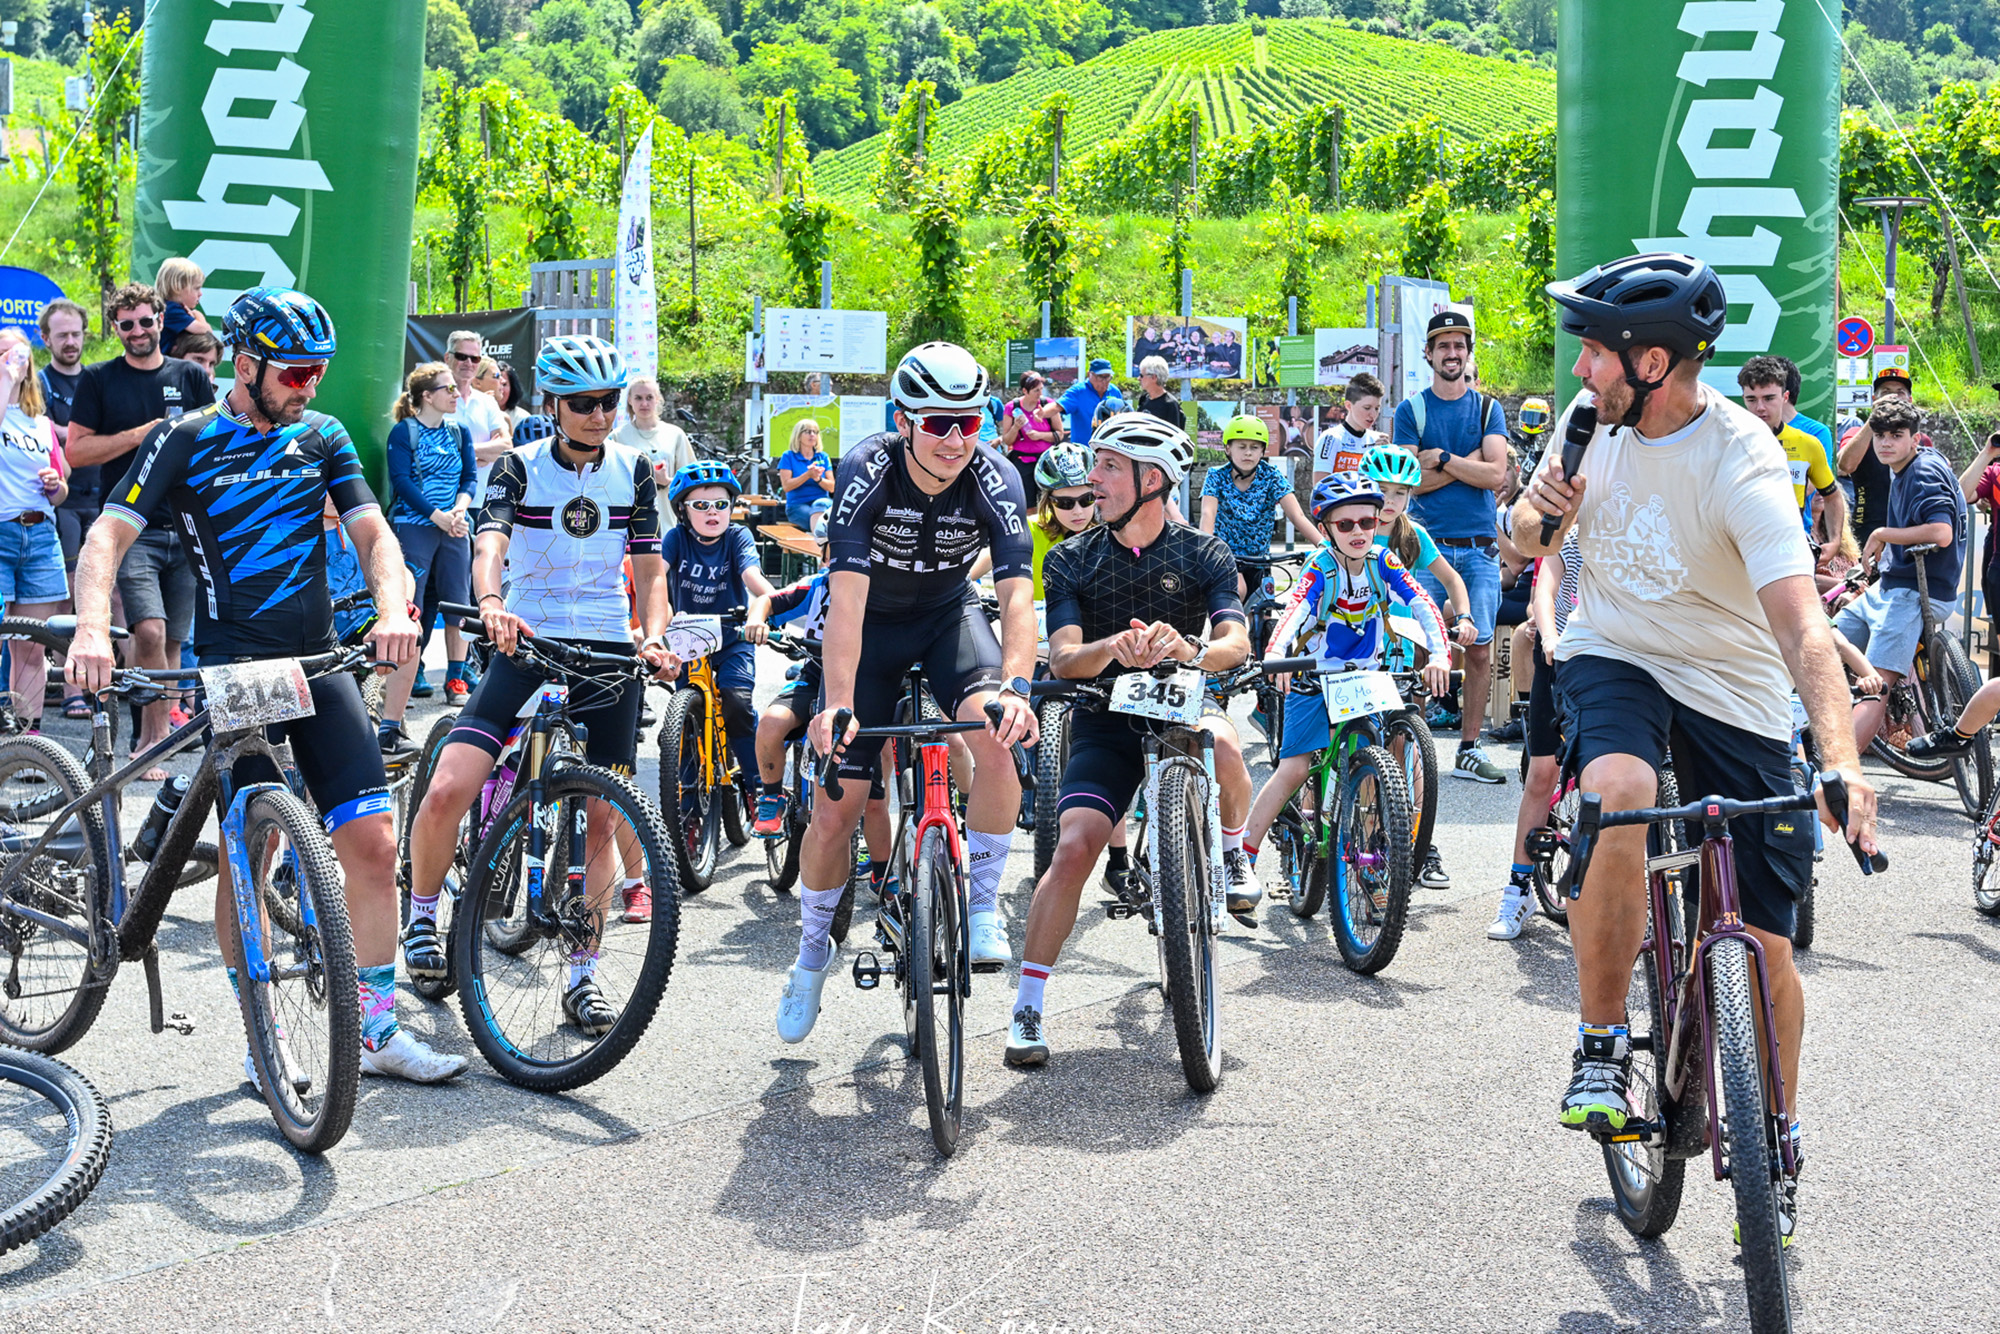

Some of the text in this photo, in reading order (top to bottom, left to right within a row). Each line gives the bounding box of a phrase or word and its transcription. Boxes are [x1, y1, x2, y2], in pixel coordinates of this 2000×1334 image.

[0, 298, 44, 316] ORTS
[489, 344, 513, 354] CUBE
[213, 451, 256, 462] S-PHYRE
[1338, 456, 1358, 465] MTB
[213, 467, 322, 487] BULLS
[836, 449, 891, 517] TRI AG
[977, 456, 1008, 497] TRI
[997, 500, 1024, 535] AG
[1855, 506, 1865, 524] ALB
[181, 511, 219, 621] BULLS
[1497, 637, 1511, 681] Wein
[224, 676, 297, 713] 214
[1127, 681, 1187, 709] 345
[1723, 911, 1738, 926] 3T
